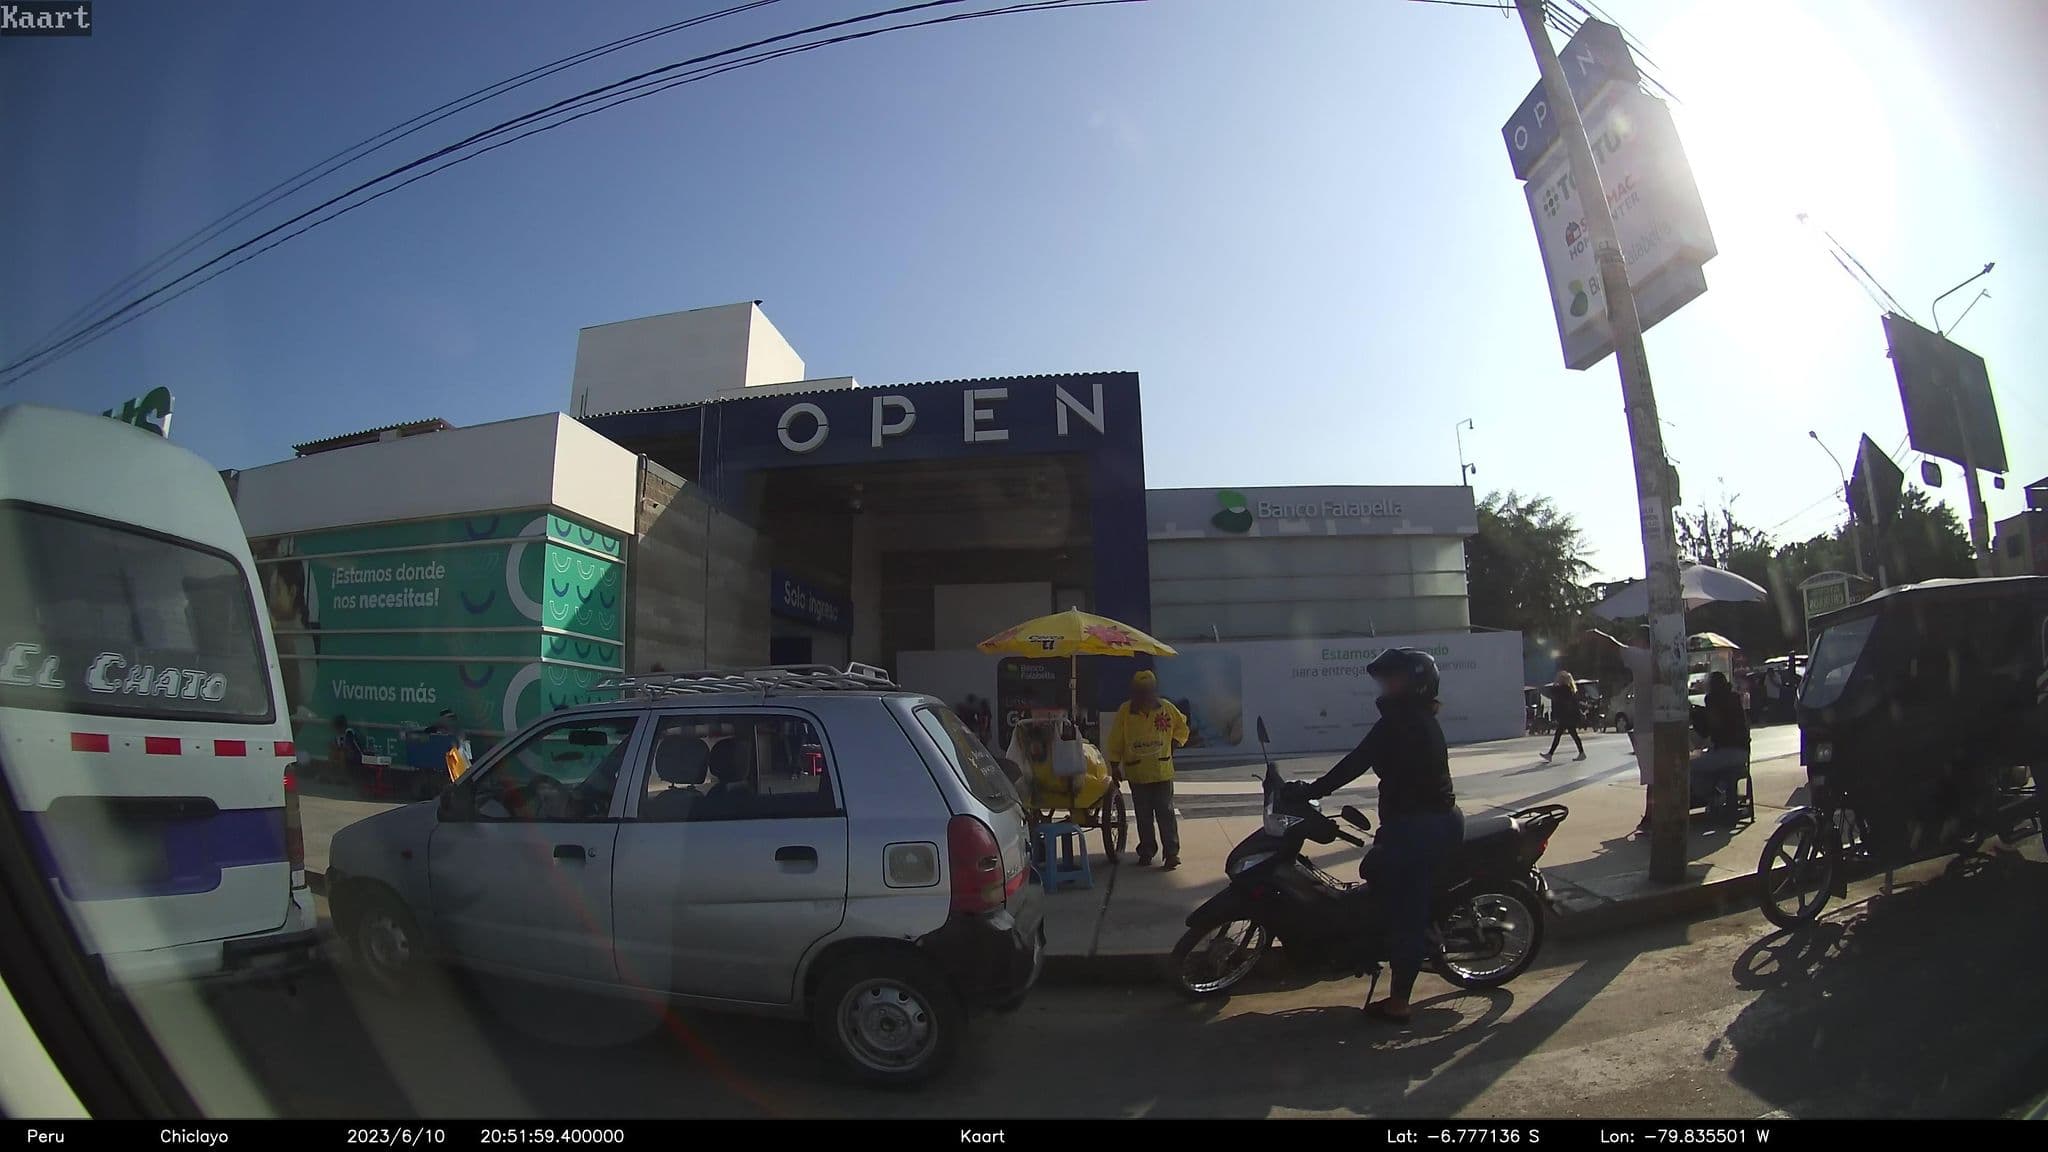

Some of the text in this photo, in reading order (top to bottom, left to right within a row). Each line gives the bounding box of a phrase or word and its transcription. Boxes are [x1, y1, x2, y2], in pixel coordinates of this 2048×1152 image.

[1513, 41, 1595, 151] OPN
[777, 383, 1105, 453] OPEN
[1258, 498, 1403, 518] Banco Falabella
[331, 561, 445, 589] ¡Estamos donde
[333, 588, 439, 609] nos necesitas!
[784, 580, 805, 609] Solo
[332, 680, 437, 703] Vivamos más
